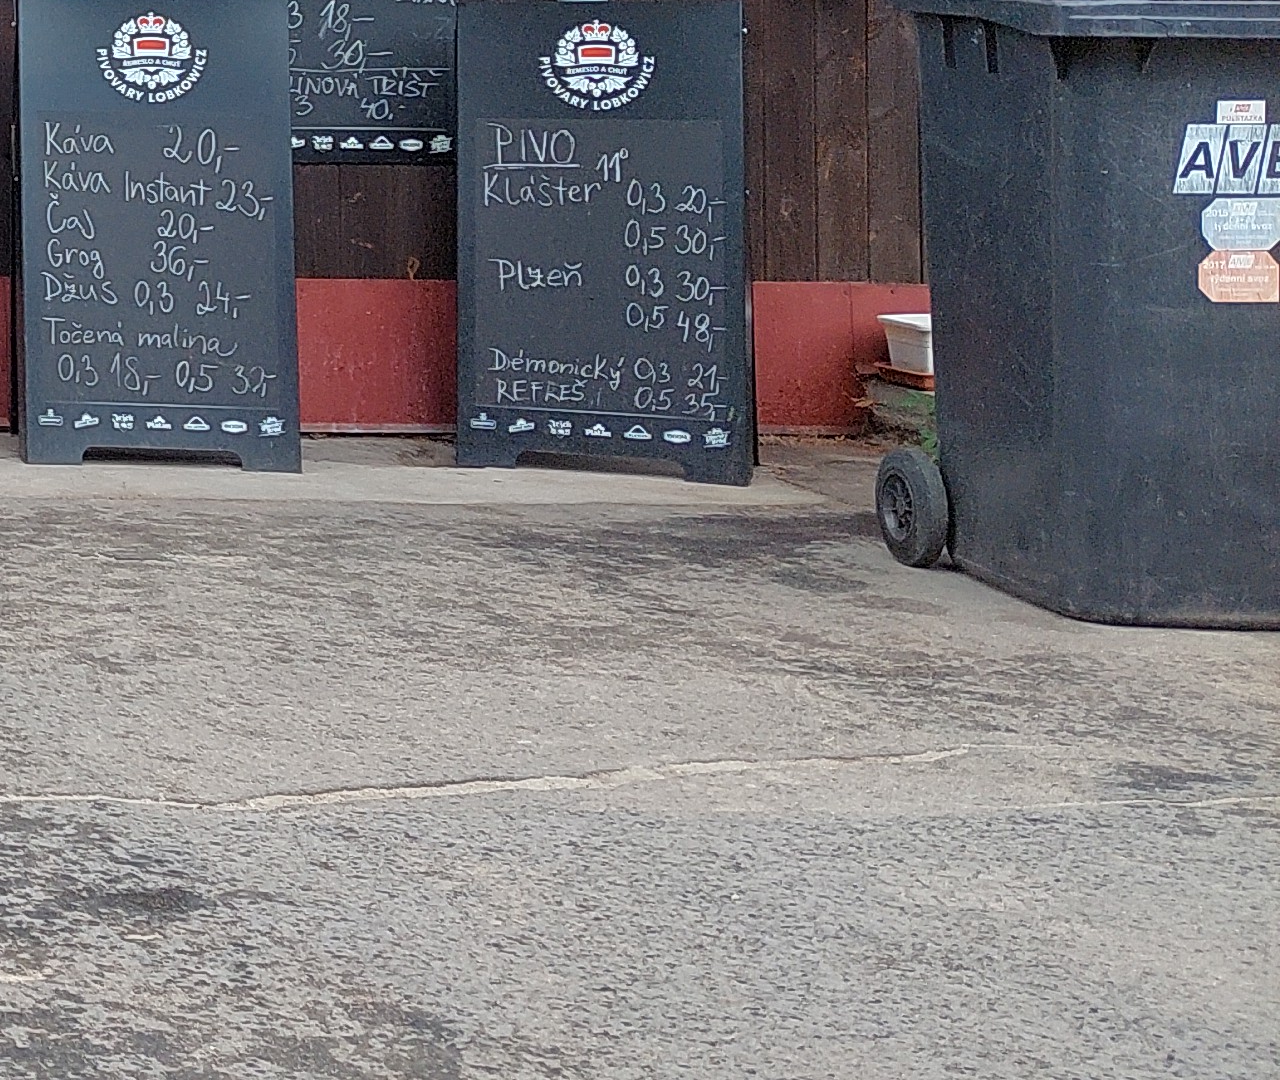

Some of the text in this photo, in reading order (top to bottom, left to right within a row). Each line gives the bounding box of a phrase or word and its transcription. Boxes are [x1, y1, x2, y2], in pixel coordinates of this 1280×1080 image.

[96, 48, 208, 103] PIVOVARY LOBKOWICZ
[539, 56, 655, 110] PIVOVARY LOBKOWICZ
[43, 121, 239, 173] Káva 20,-
[488, 122, 576, 165] PIVO
[43, 160, 274, 220] Káva Instant 23,-
[483, 172, 601, 206] Klášter
[626, 178, 666, 215] 0,3
[674, 185, 727, 222] 20,-
[46, 191, 214, 243] Čaj 20,-
[624, 219, 727, 261] 0,5 30,-
[47, 239, 209, 281] Grog 36,-
[488, 258, 728, 306] Plzeň 0,3 30,-
[40, 271, 251, 318] Džus 0,3 24,-
[42, 317, 238, 356] Točená malina
[625, 302, 727, 352] 0,5 48,-
[57, 352, 277, 397] 0,3 18,- 0,5 32,-
[488, 348, 727, 394] Démonický 0,3 21,-
[634, 387, 675, 411] 0,5
[682, 394, 727, 421] 35,-
